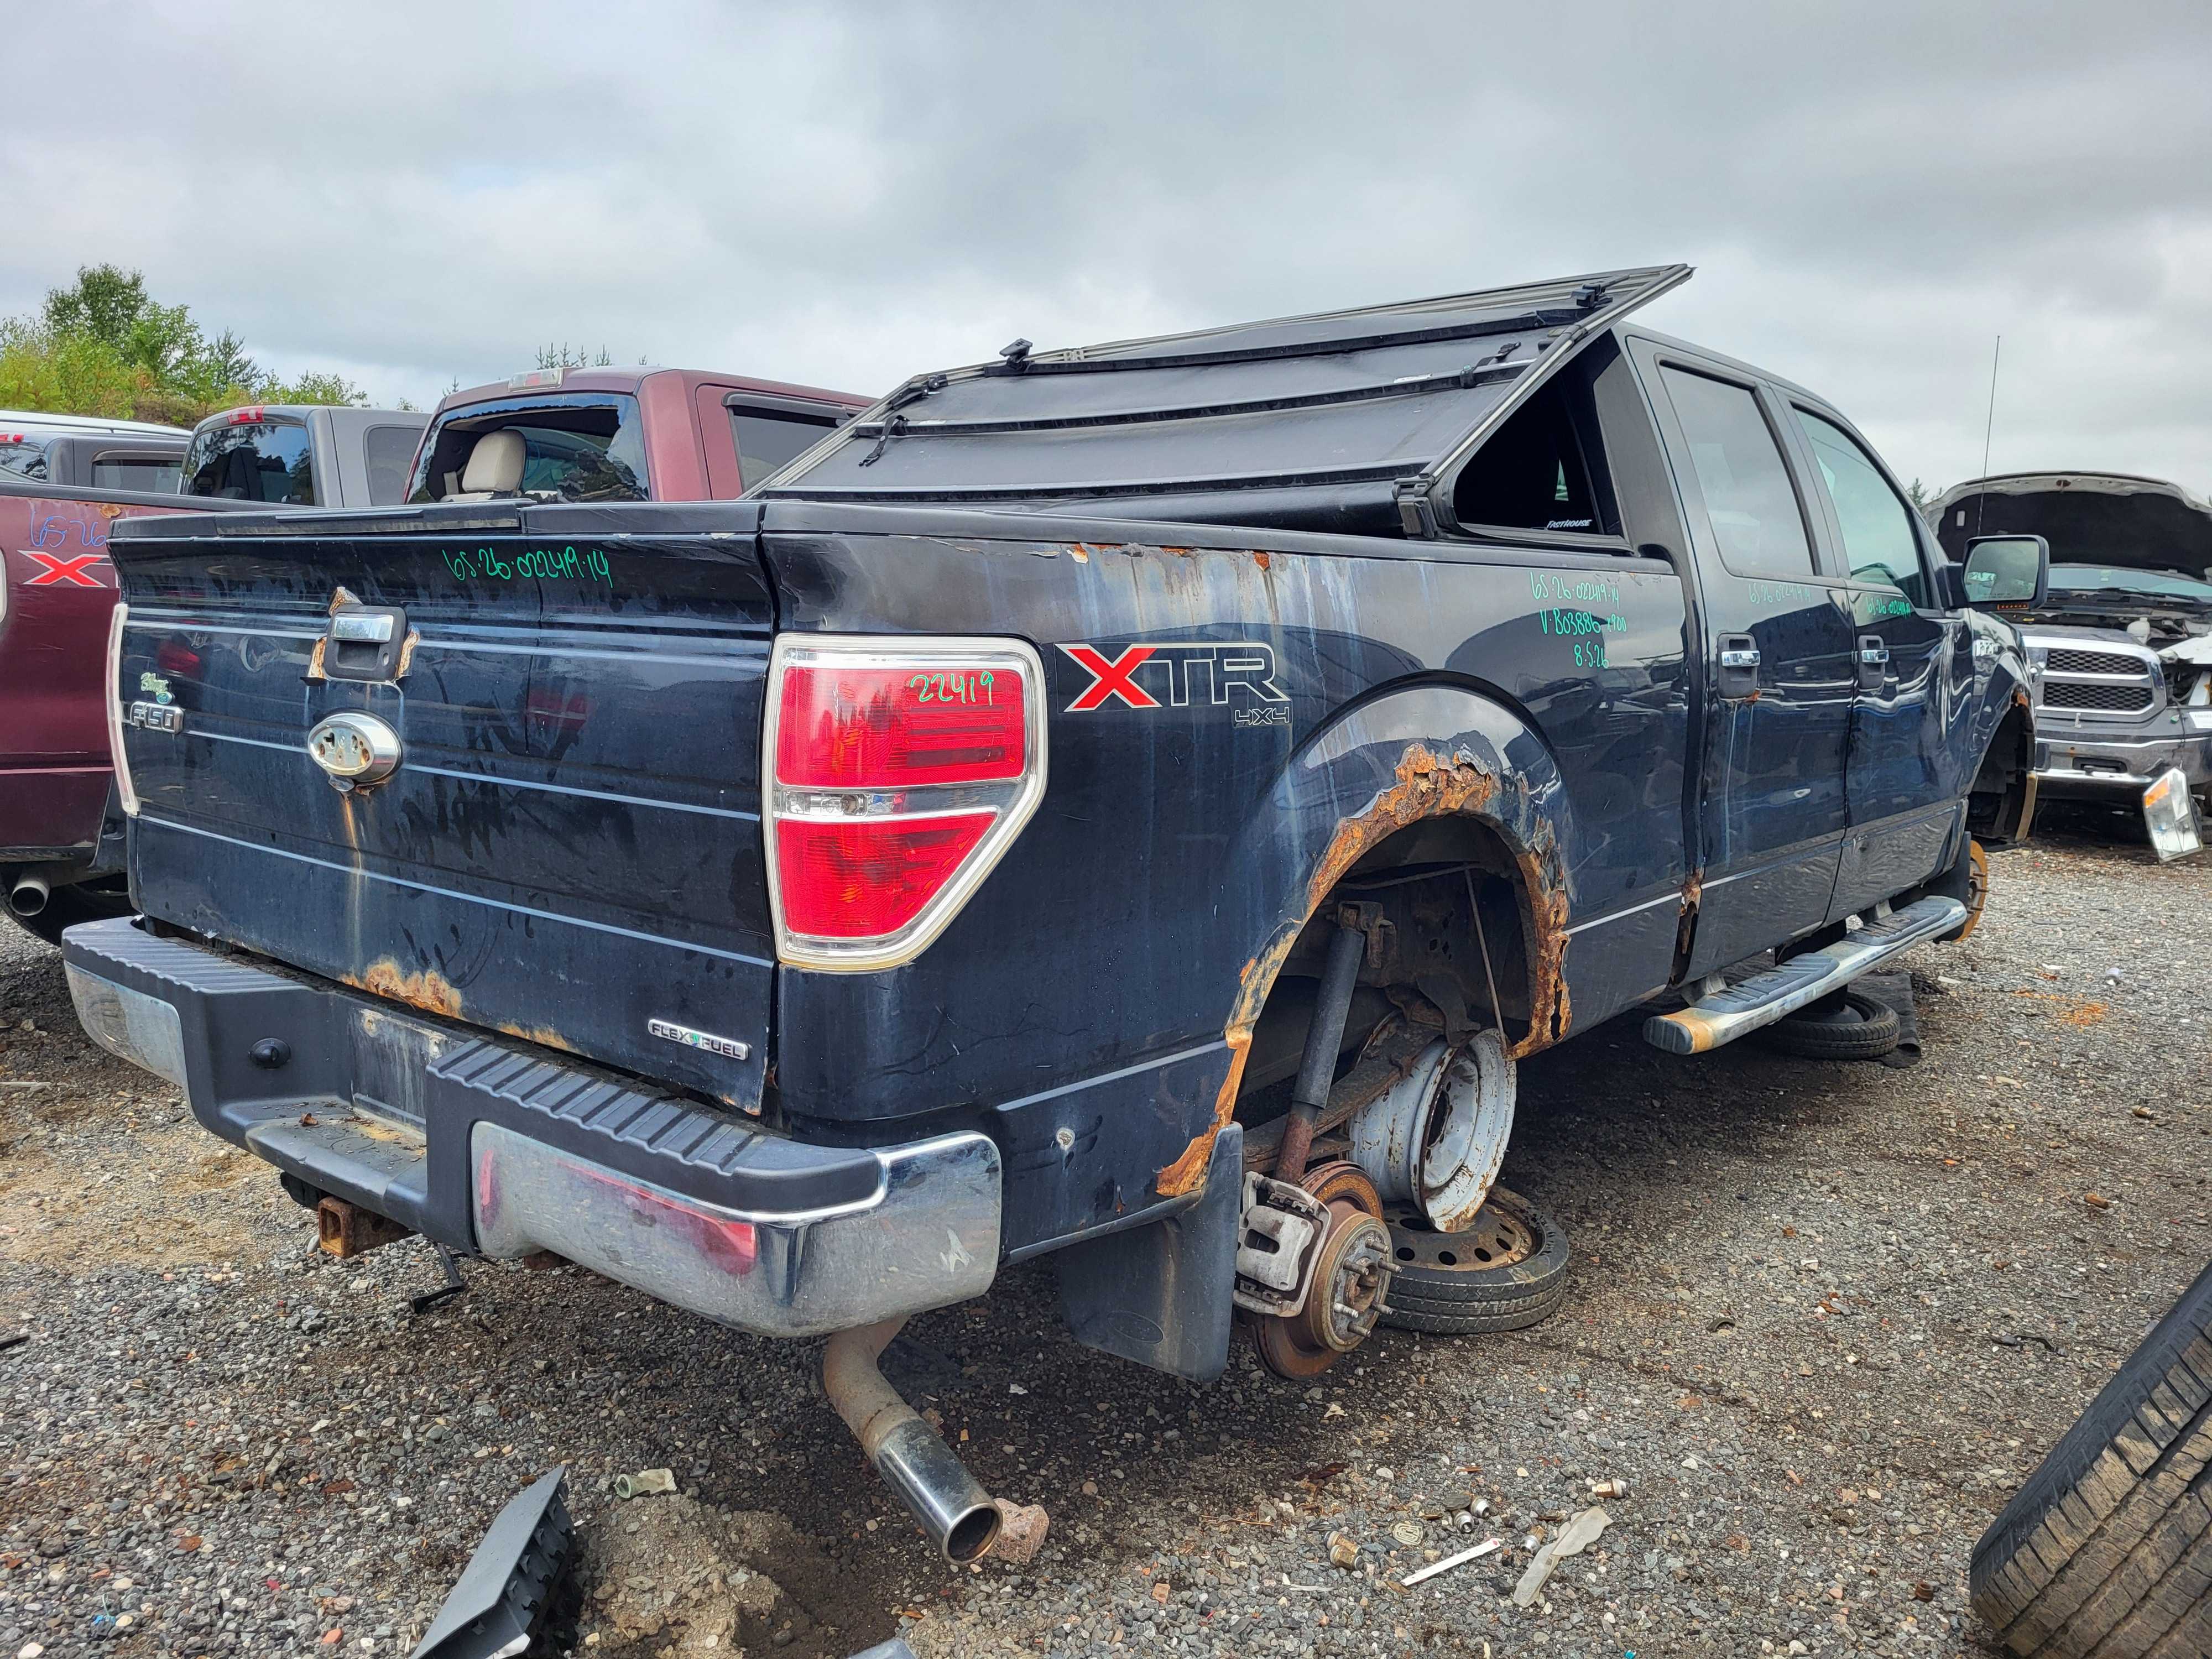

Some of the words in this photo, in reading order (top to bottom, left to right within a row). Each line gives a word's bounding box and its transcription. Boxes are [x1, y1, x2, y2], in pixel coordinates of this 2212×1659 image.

[1547, 519, 1592, 528] FASTHOUSE
[910, 671, 994, 706] 22419
[1055, 643, 1292, 712] XTR
[652, 1024, 689, 1042] FLEX
[701, 1039, 741, 1057] FUEL
